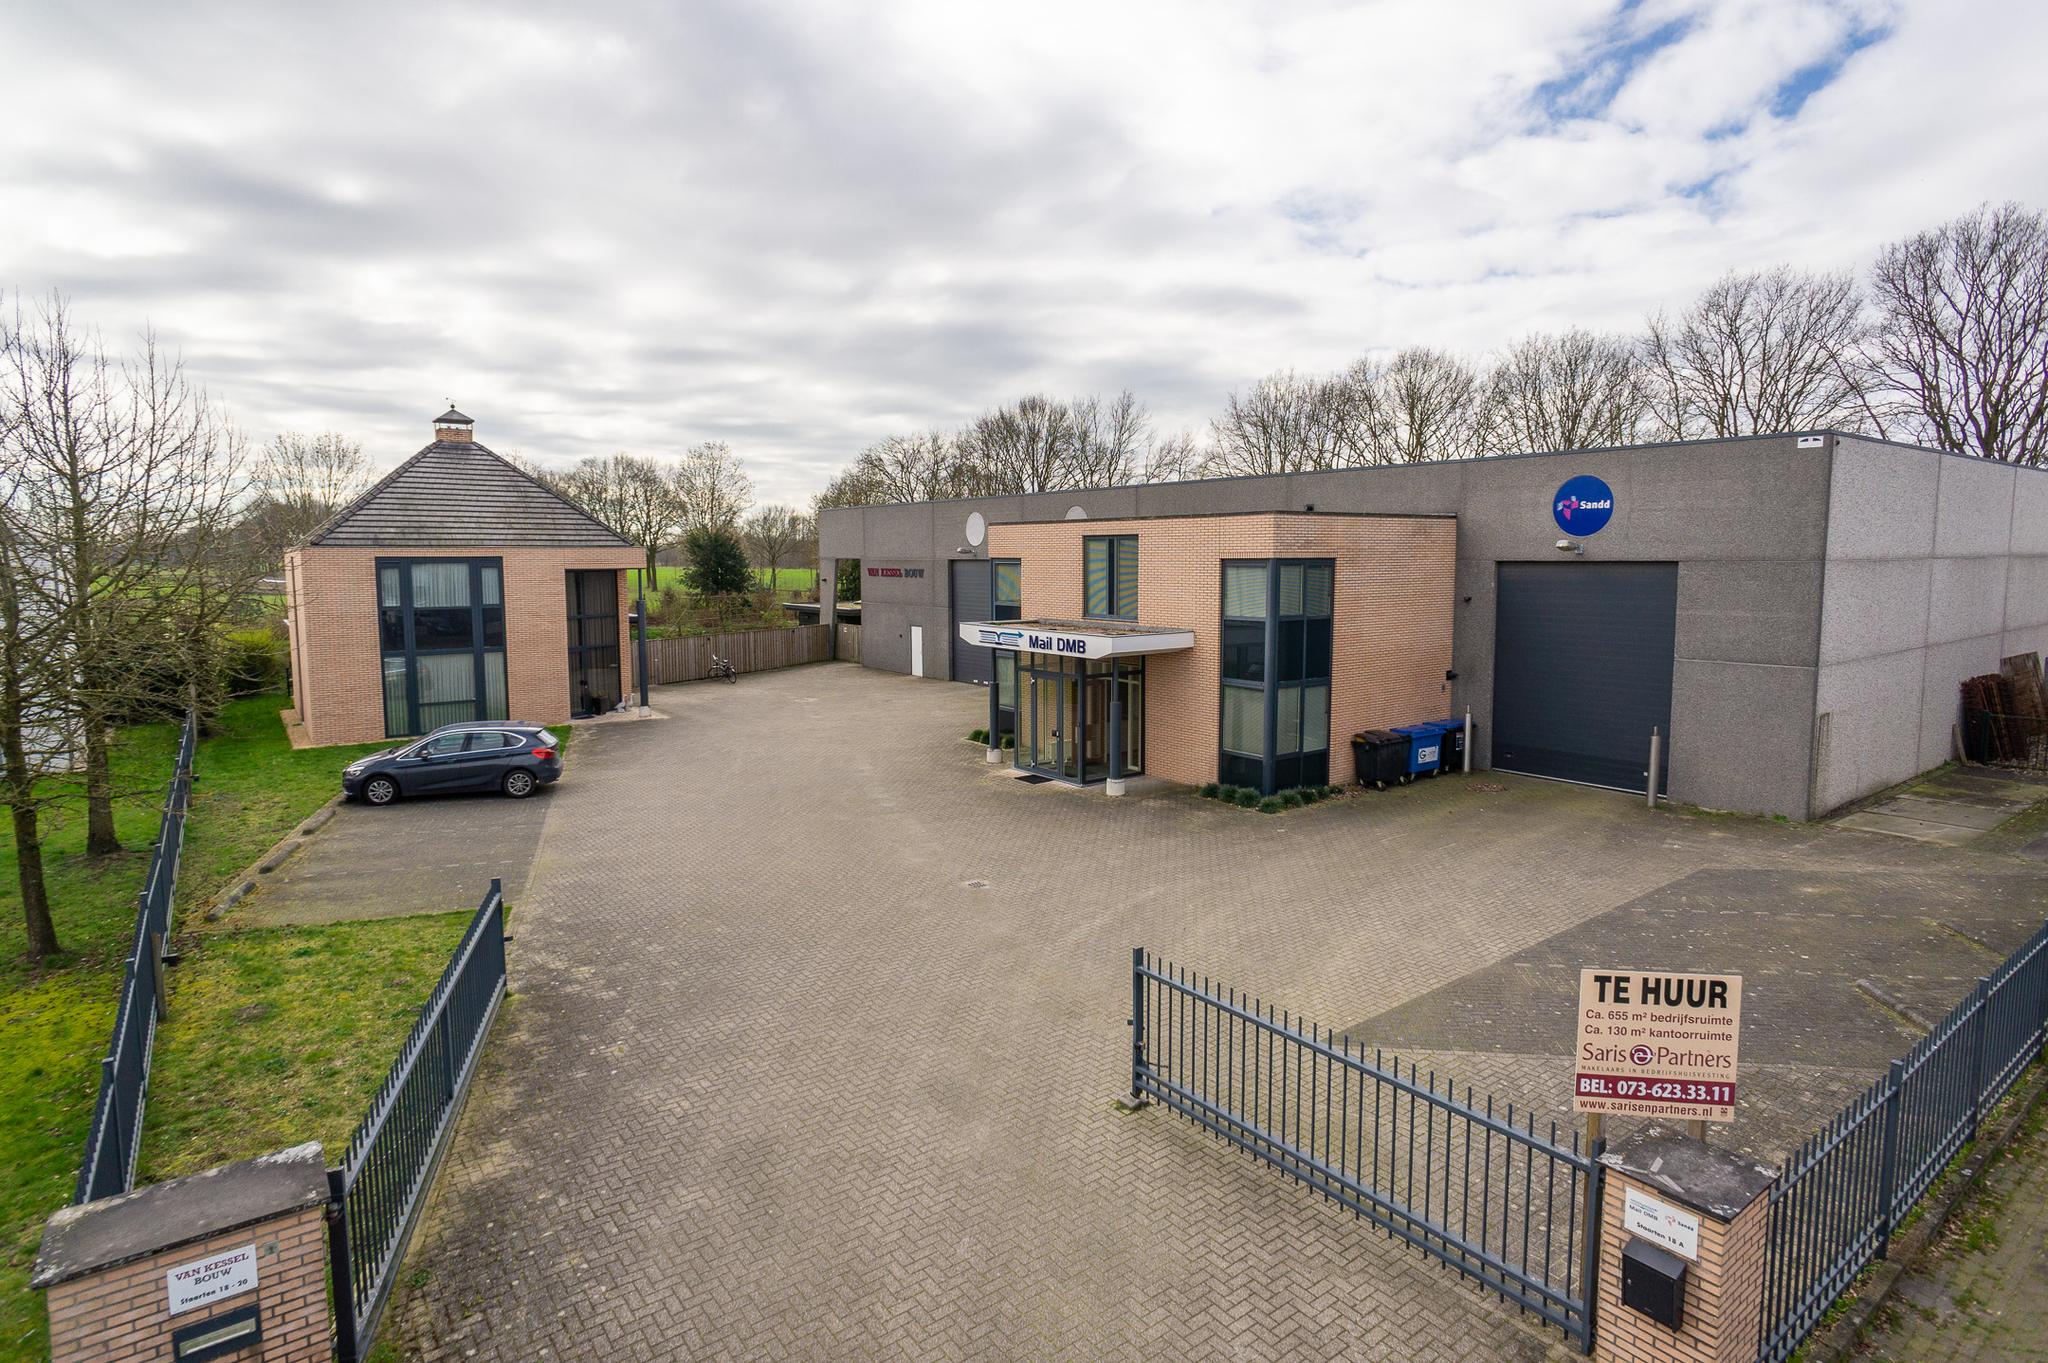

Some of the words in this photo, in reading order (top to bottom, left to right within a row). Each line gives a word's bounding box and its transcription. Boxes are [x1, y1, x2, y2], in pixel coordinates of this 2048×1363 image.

[1580, 500, 1610, 509] Sandd
[1028, 635, 1052, 650] Mail
[1056, 638, 1086, 654] DMB
[1594, 975, 1630, 1004] TE
[1641, 977, 1728, 1008] HUUR
[1586, 1009, 1604, 1020] Ca.
[1608, 1010, 1628, 1021] 655
[1650, 1013, 1733, 1026] bedrijfsruimte
[1584, 1024, 1603, 1035] Ca.
[1608, 1026, 1628, 1036] 130
[1649, 1028, 1732, 1041] kantoorruimte
[1582, 1042, 1626, 1063] Saris
[1657, 1046, 1732, 1069] Partners
[1581, 1065, 1624, 1073] MAKELAARS
[1641, 1068, 1730, 1080] BEDRIJFSHUISVESTING
[1580, 1078, 1612, 1094] BEL:
[1616, 1080, 1730, 1102] 073-623.33.11
[1580, 1100, 1712, 1116] www.sarisenpartners.nl
[1668, 1236, 1676, 1244] 18
[174, 1267, 201, 1282] VAN
[204, 1252, 250, 1273] KESSEL
[194, 1267, 232, 1286] BOUW
[180, 1290, 216, 1305] Staarten
[219, 1284, 230, 1293] 18
[238, 1278, 248, 1287] 20
